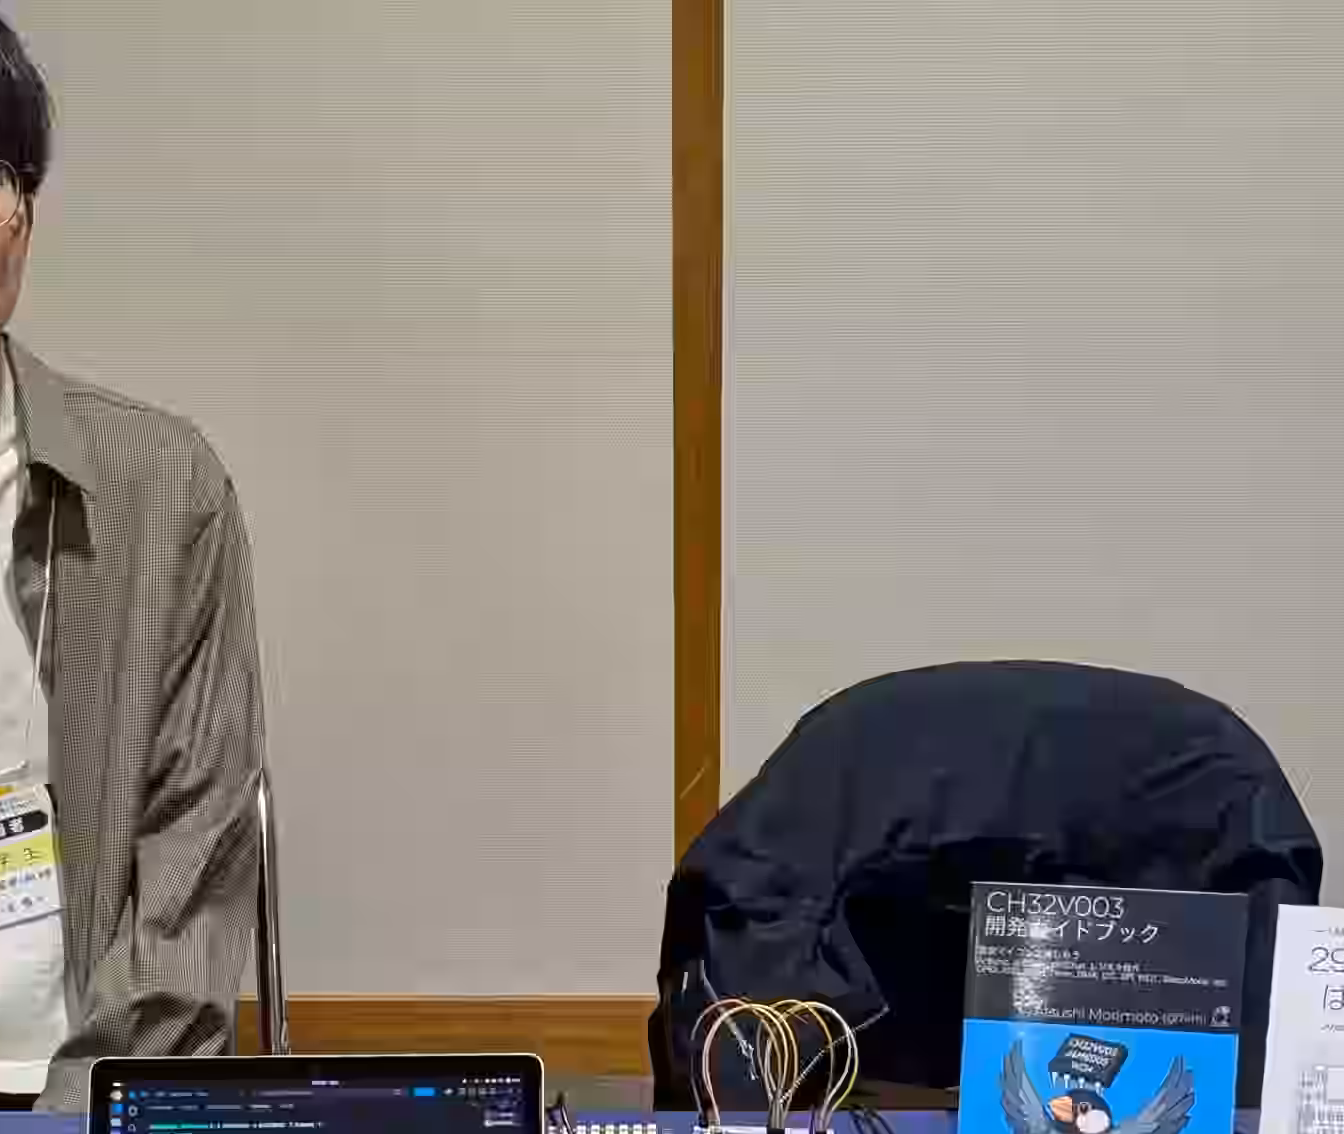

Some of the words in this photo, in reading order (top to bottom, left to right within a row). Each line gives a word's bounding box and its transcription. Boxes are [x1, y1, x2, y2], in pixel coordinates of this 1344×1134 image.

[987, 890, 1124, 919] CH32V003
[985, 914, 1159, 944] 開発イドブック
